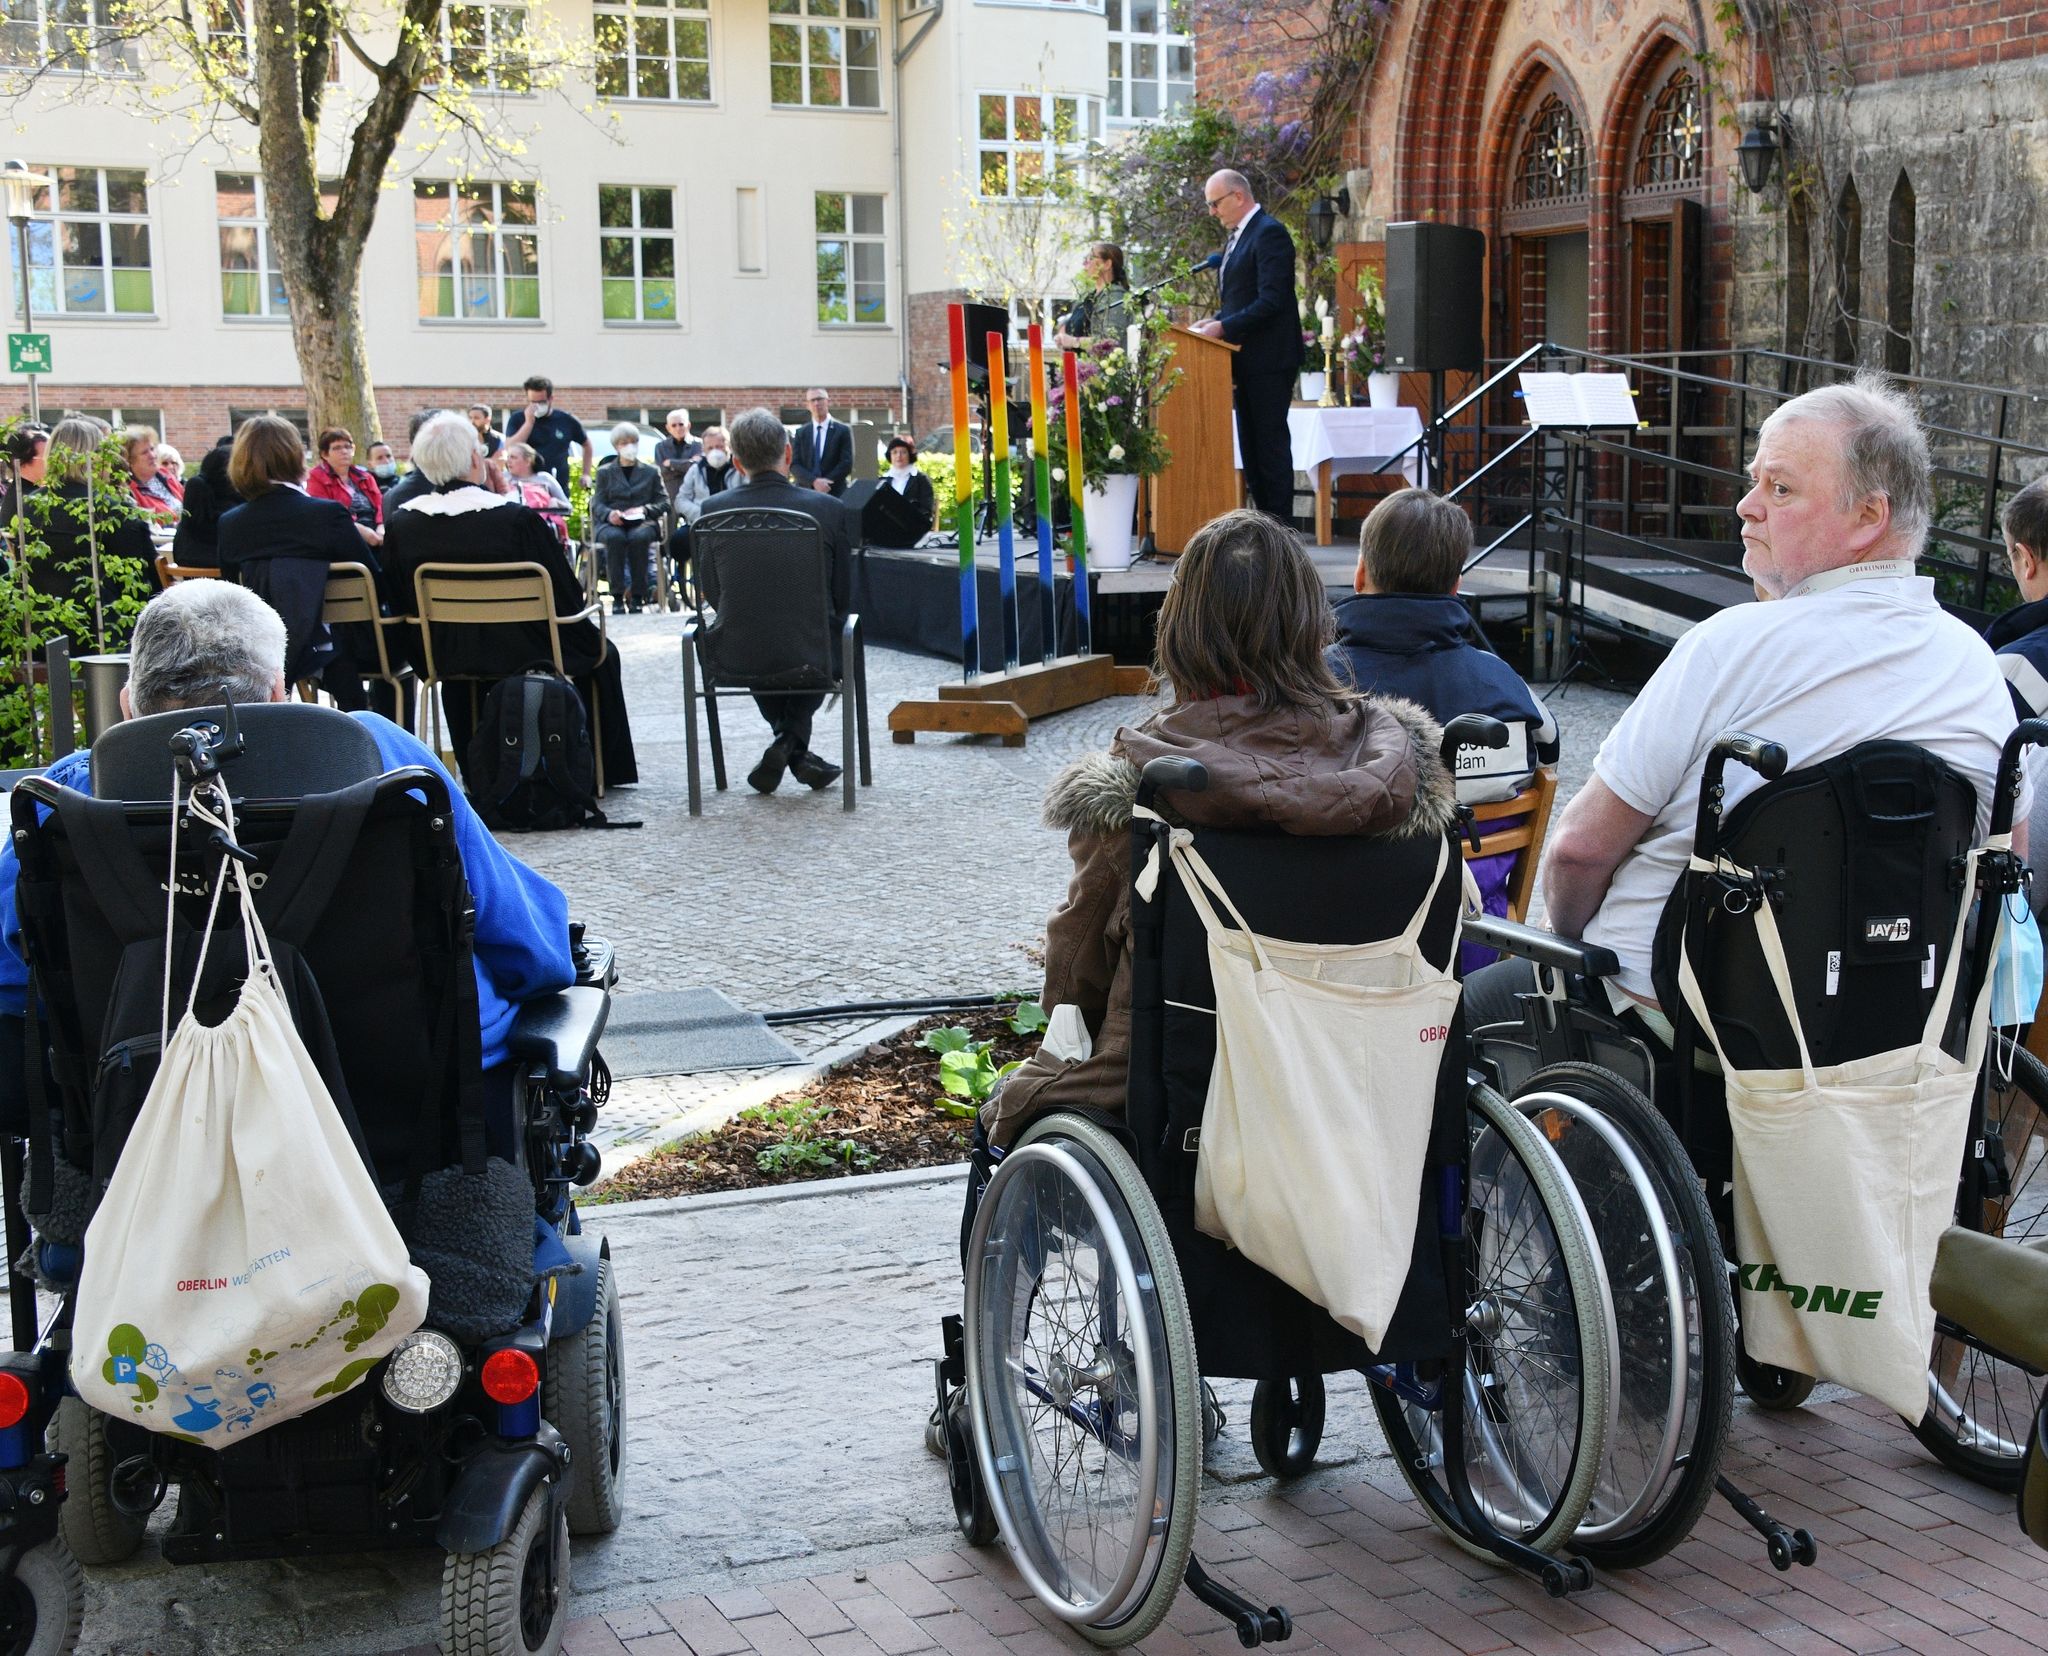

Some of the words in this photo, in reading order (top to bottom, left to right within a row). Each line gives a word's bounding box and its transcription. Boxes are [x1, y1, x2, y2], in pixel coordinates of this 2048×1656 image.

[1849, 563, 1897, 573] OBERLINHAUS
[1867, 923, 1891, 937] JAY
[177, 1278, 227, 1292] OBERLIN
[118, 1361, 132, 1377] P
